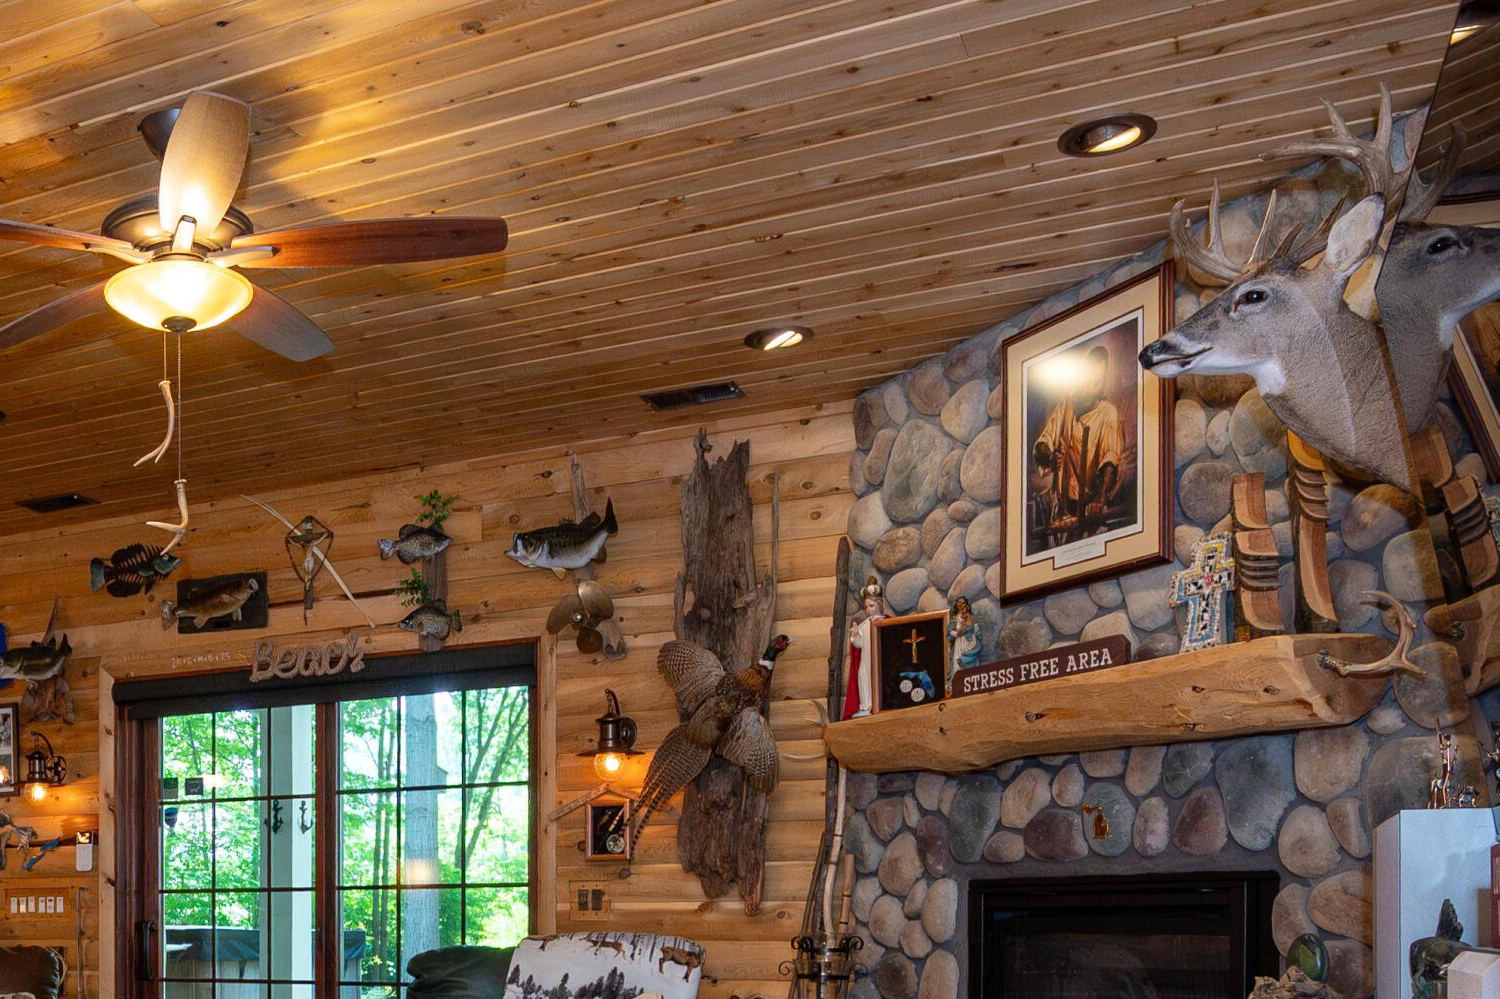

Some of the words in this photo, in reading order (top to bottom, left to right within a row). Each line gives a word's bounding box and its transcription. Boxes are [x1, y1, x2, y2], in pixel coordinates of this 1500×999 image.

[963, 667, 1014, 693] STRESS
[1019, 657, 1059, 682] FREE
[1065, 647, 1113, 673] AREA
